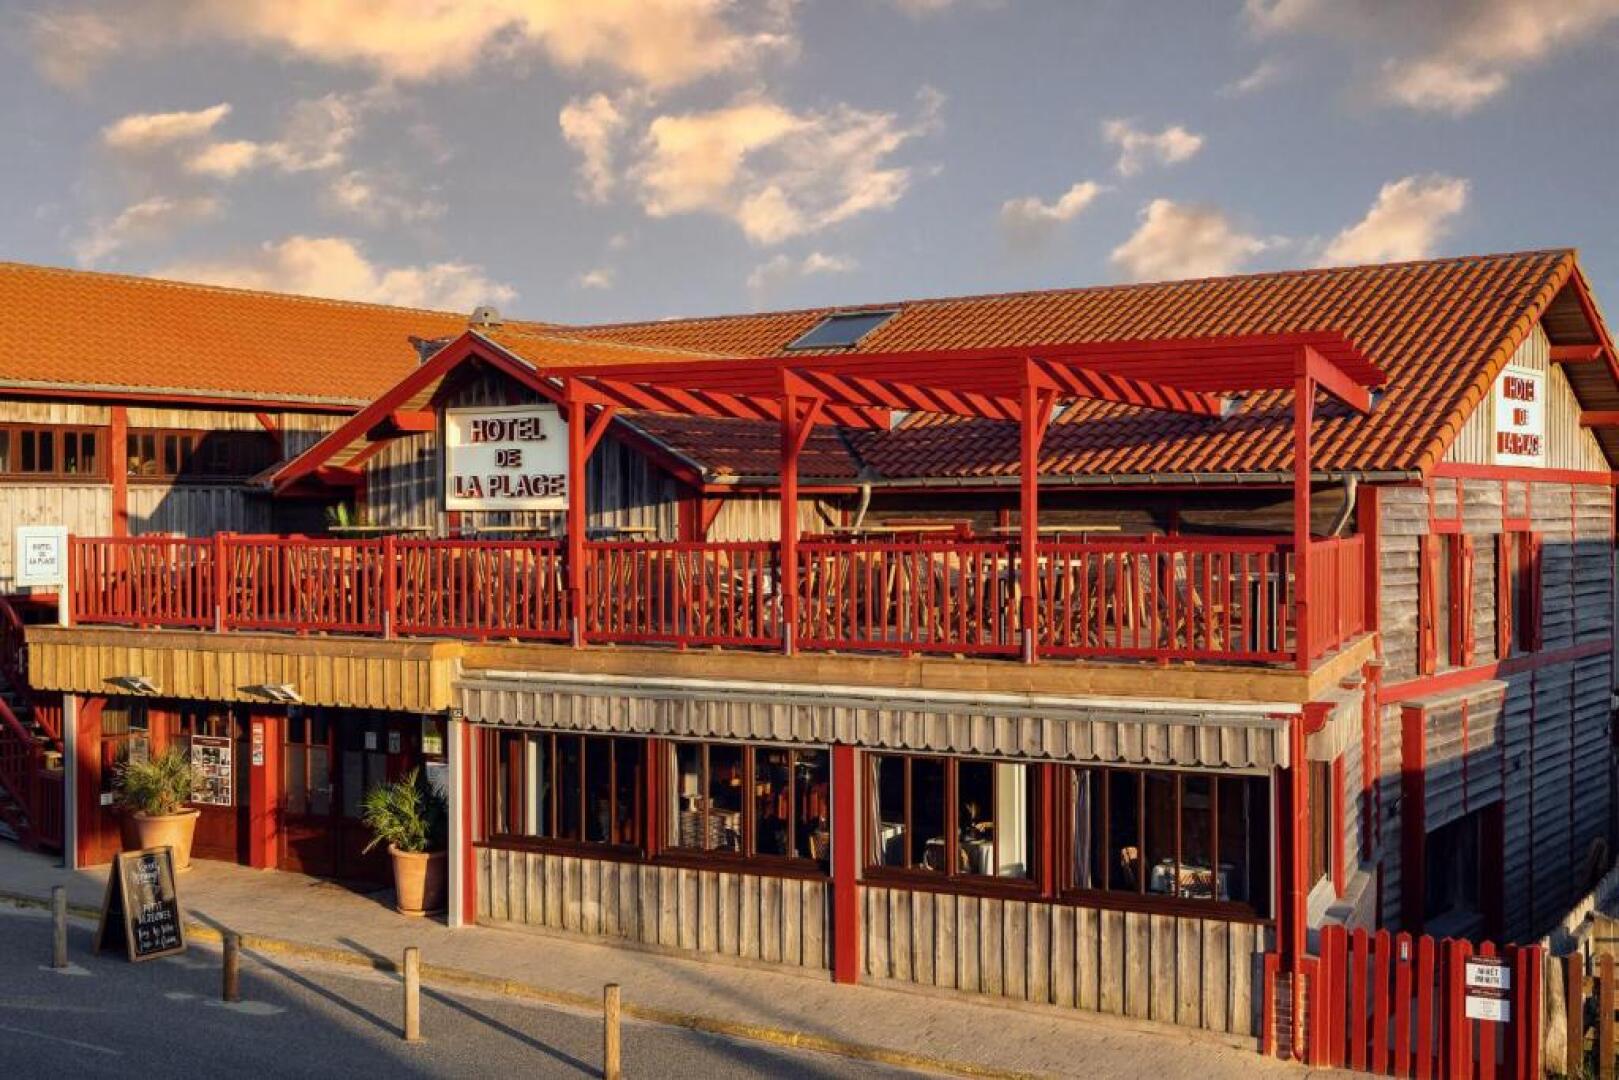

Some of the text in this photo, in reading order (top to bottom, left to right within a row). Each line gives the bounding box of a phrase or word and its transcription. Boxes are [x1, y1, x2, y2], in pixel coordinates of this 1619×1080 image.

[1513, 408, 1528, 426] DE
[471, 417, 547, 443] HOTEL
[495, 448, 523, 468] DE
[454, 474, 567, 498] LA PLAGE
